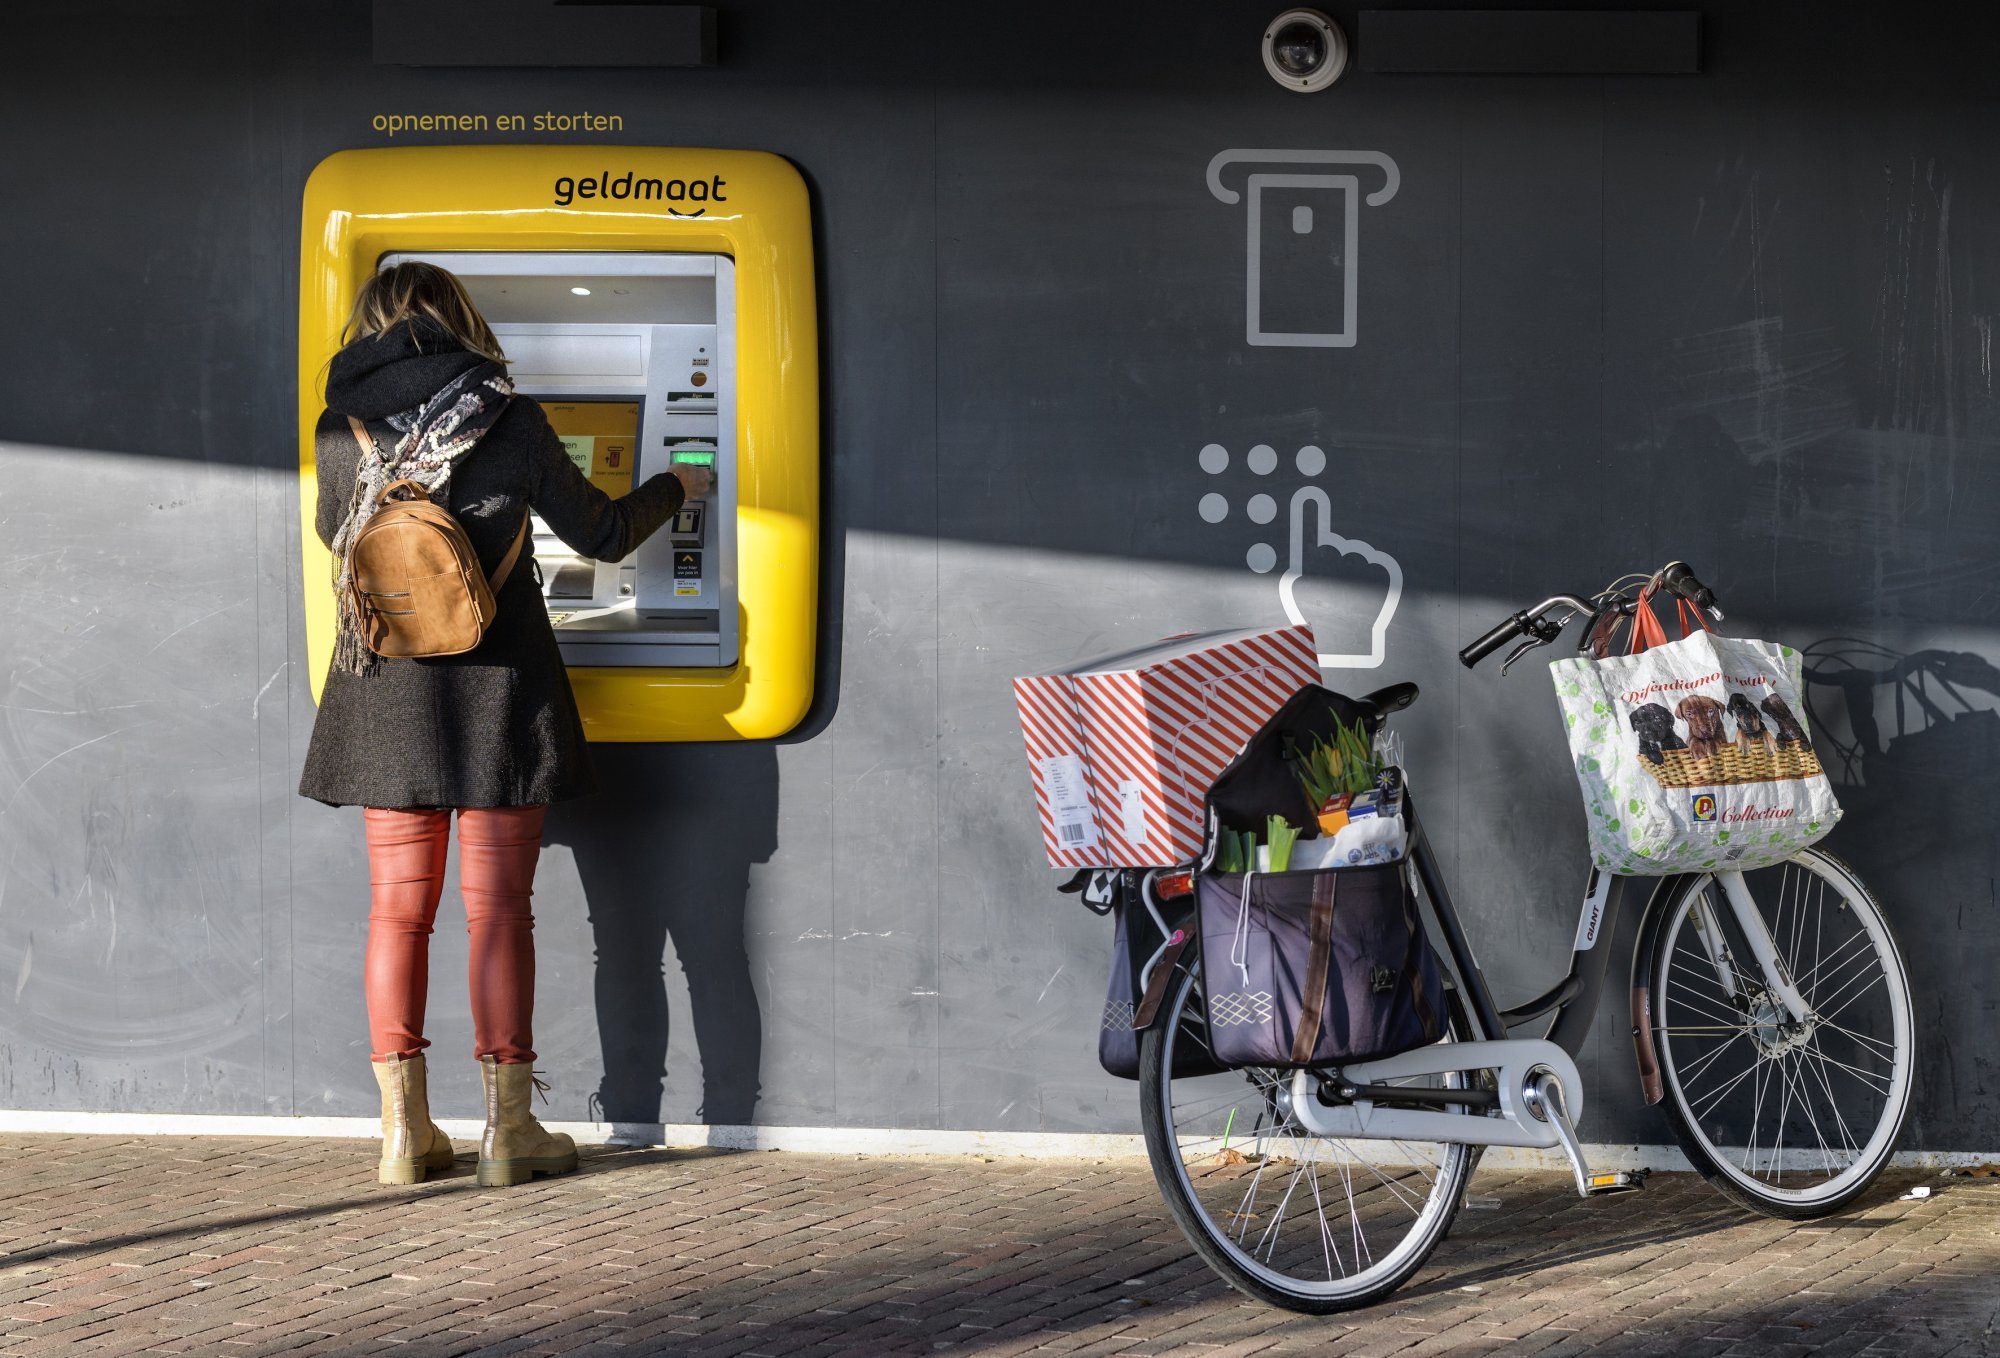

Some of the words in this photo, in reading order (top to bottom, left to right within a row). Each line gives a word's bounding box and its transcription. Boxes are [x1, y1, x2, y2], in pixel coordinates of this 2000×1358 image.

[372, 114, 488, 137] opnemen
[496, 114, 526, 131] en
[533, 111, 623, 131] storten
[554, 171, 728, 206] geldmaat
[1721, 804, 1794, 824] Collection
[1587, 905, 1598, 941] GIANT
